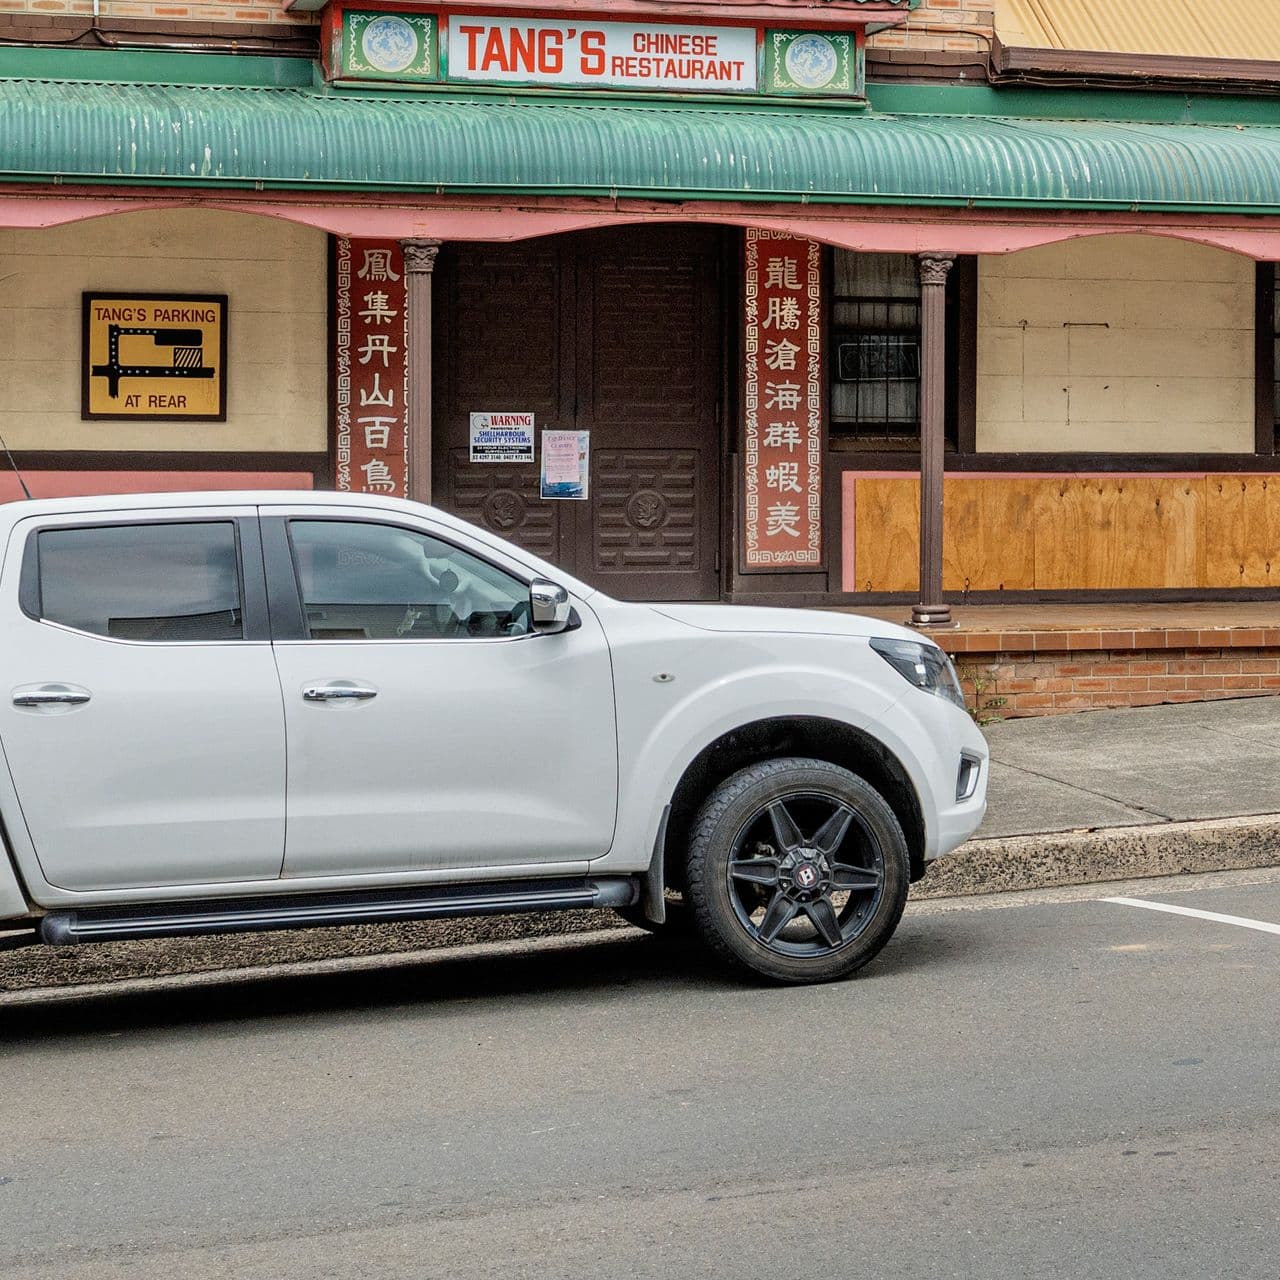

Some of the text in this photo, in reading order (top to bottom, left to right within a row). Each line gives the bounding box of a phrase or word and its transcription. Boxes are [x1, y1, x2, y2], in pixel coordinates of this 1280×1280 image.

[459, 25, 718, 76] TANG'S CHINESE
[611, 56, 745, 81] RESTAURANT
[94, 307, 216, 323] TANG'S PARKING
[124, 395, 187, 408] AT REAR
[490, 415, 531, 426] WARNING
